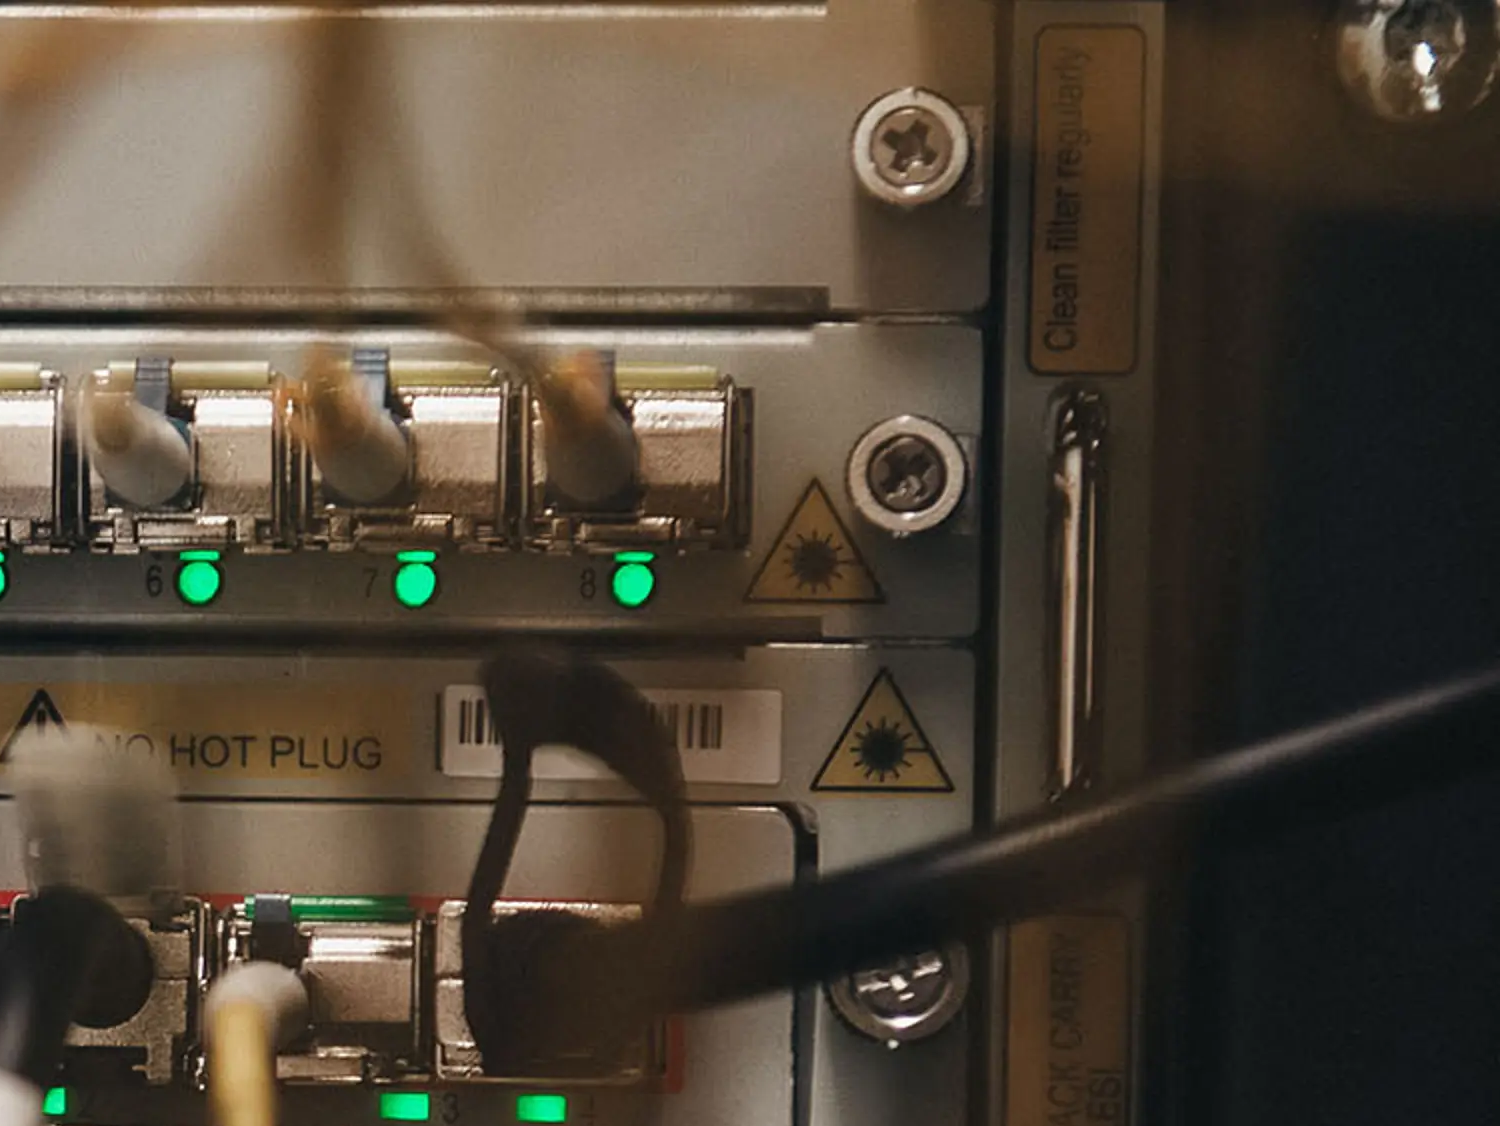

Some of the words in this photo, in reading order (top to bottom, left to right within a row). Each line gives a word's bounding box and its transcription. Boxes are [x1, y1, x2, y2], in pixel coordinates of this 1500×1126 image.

[1050, 45, 1092, 179] regularly
[1045, 184, 1080, 254] filter
[1043, 262, 1079, 353] Clean
[146, 565, 164, 597] 6
[362, 567, 379, 598] 7
[579, 568, 597, 599] 8
[170, 734, 257, 768] HOT
[269, 734, 383, 770] PLUG
[442, 1092, 459, 1124] 3
